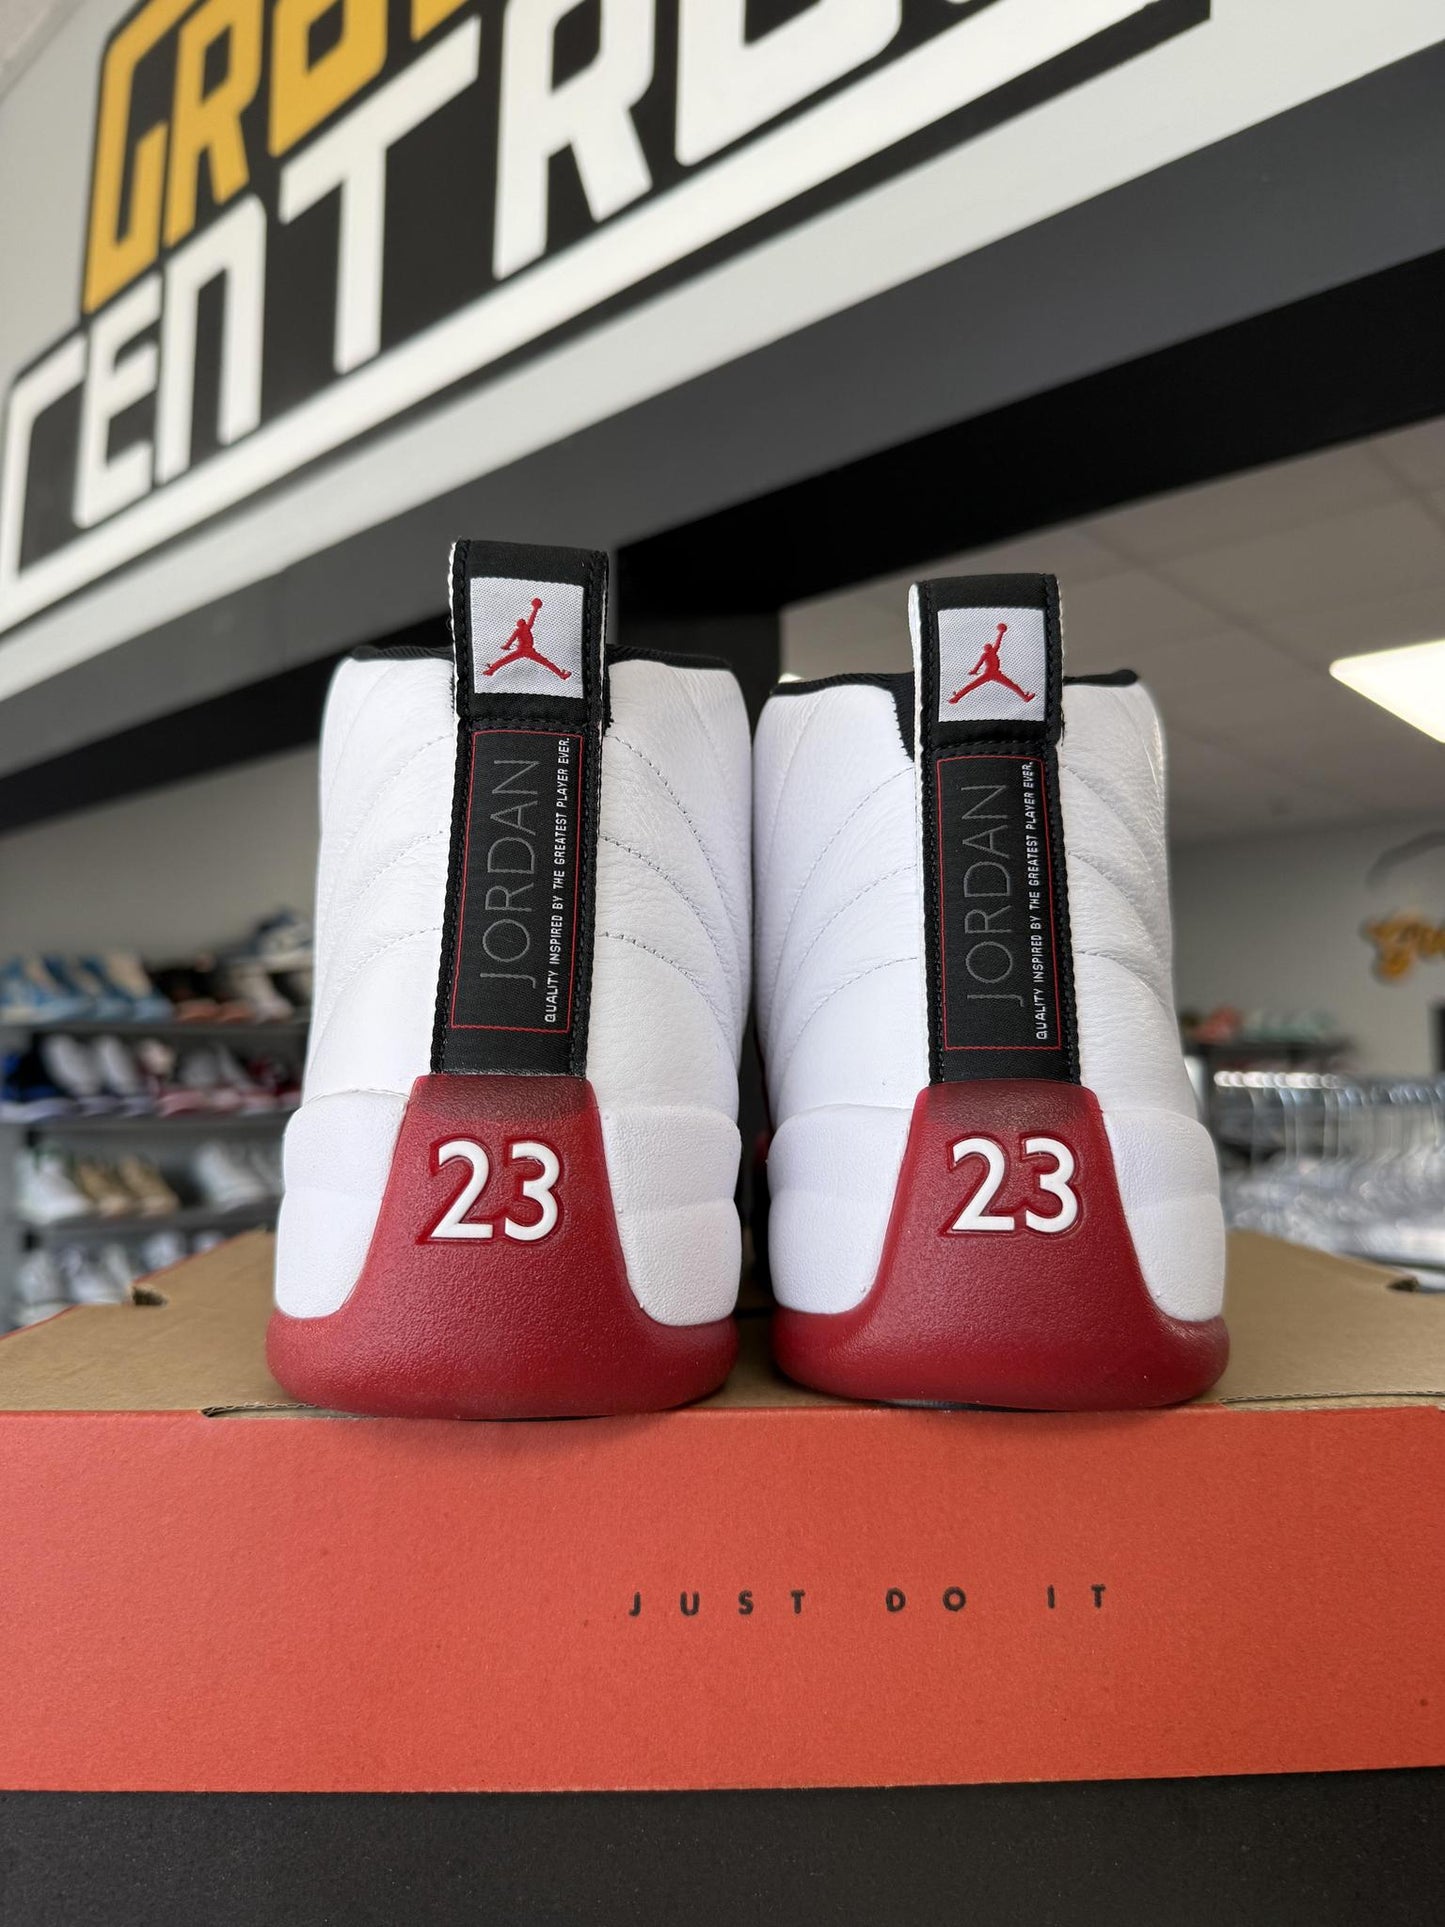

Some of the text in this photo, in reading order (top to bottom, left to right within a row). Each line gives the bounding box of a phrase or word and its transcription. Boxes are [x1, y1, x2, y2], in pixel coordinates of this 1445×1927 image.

[479, 759, 540, 989] JORDAN
[544, 737, 570, 1023] QUALITY INSPIRED BY THE GREATEST PLAYER EVER.
[961, 784, 1024, 1007] JORDAN
[1021, 761, 1048, 1040] QUALITY INSPIRED BY THE GREATEST PLAYER EVER.
[429, 1140, 561, 1242] 23
[951, 1137, 1078, 1235] 23
[629, 1583, 1106, 1617] JUST DO IT
